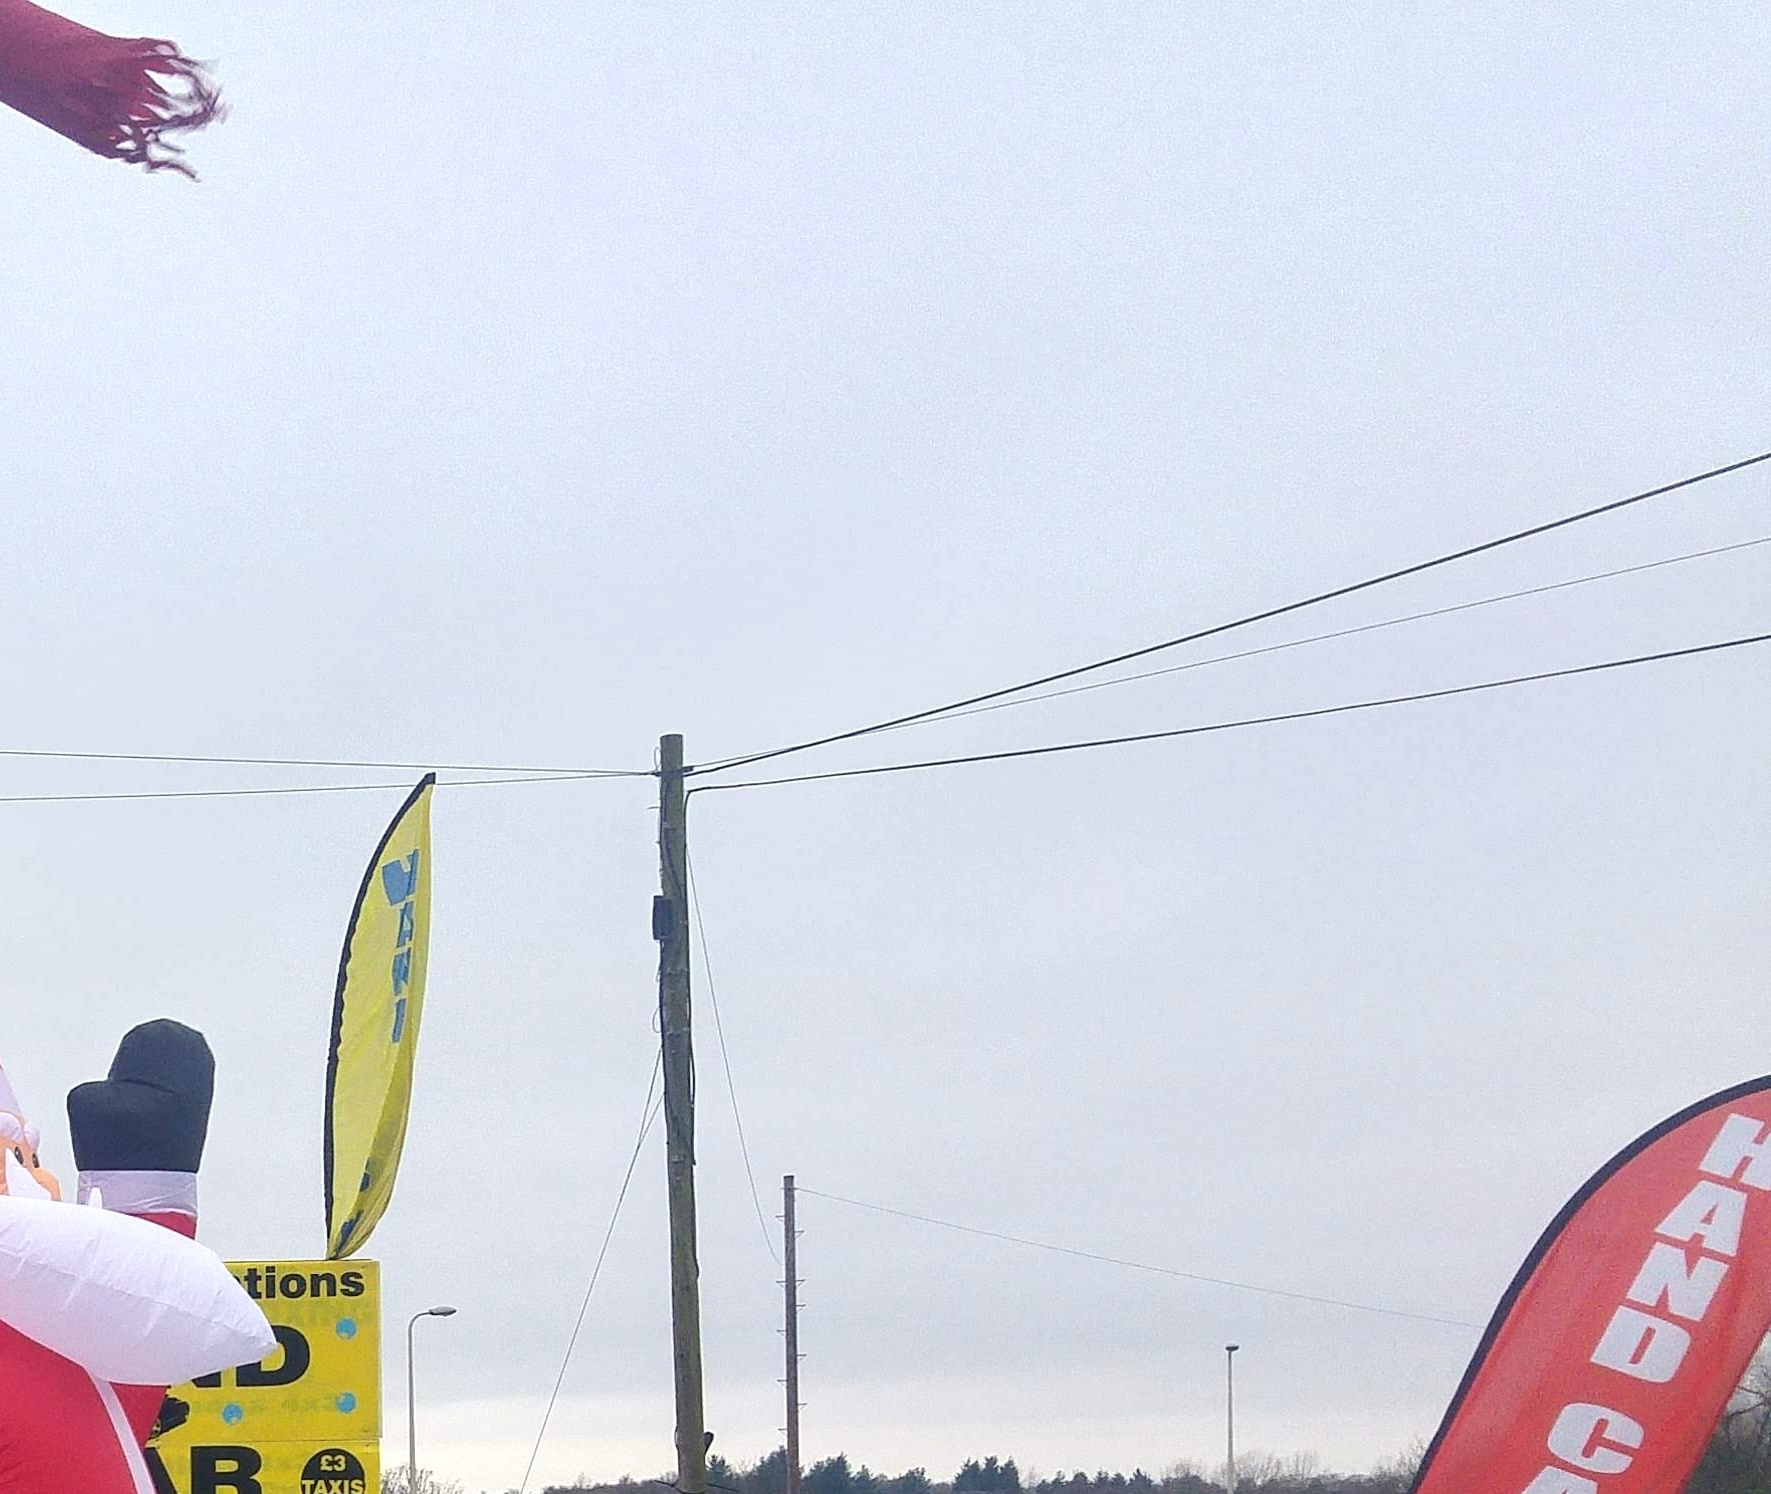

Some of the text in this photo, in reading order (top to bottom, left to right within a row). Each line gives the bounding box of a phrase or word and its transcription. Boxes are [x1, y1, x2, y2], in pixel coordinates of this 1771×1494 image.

[1590, 1113, 1771, 1383] HAND
[235, 1266, 365, 1299] tions
[320, 1455, 347, 1472] £3
